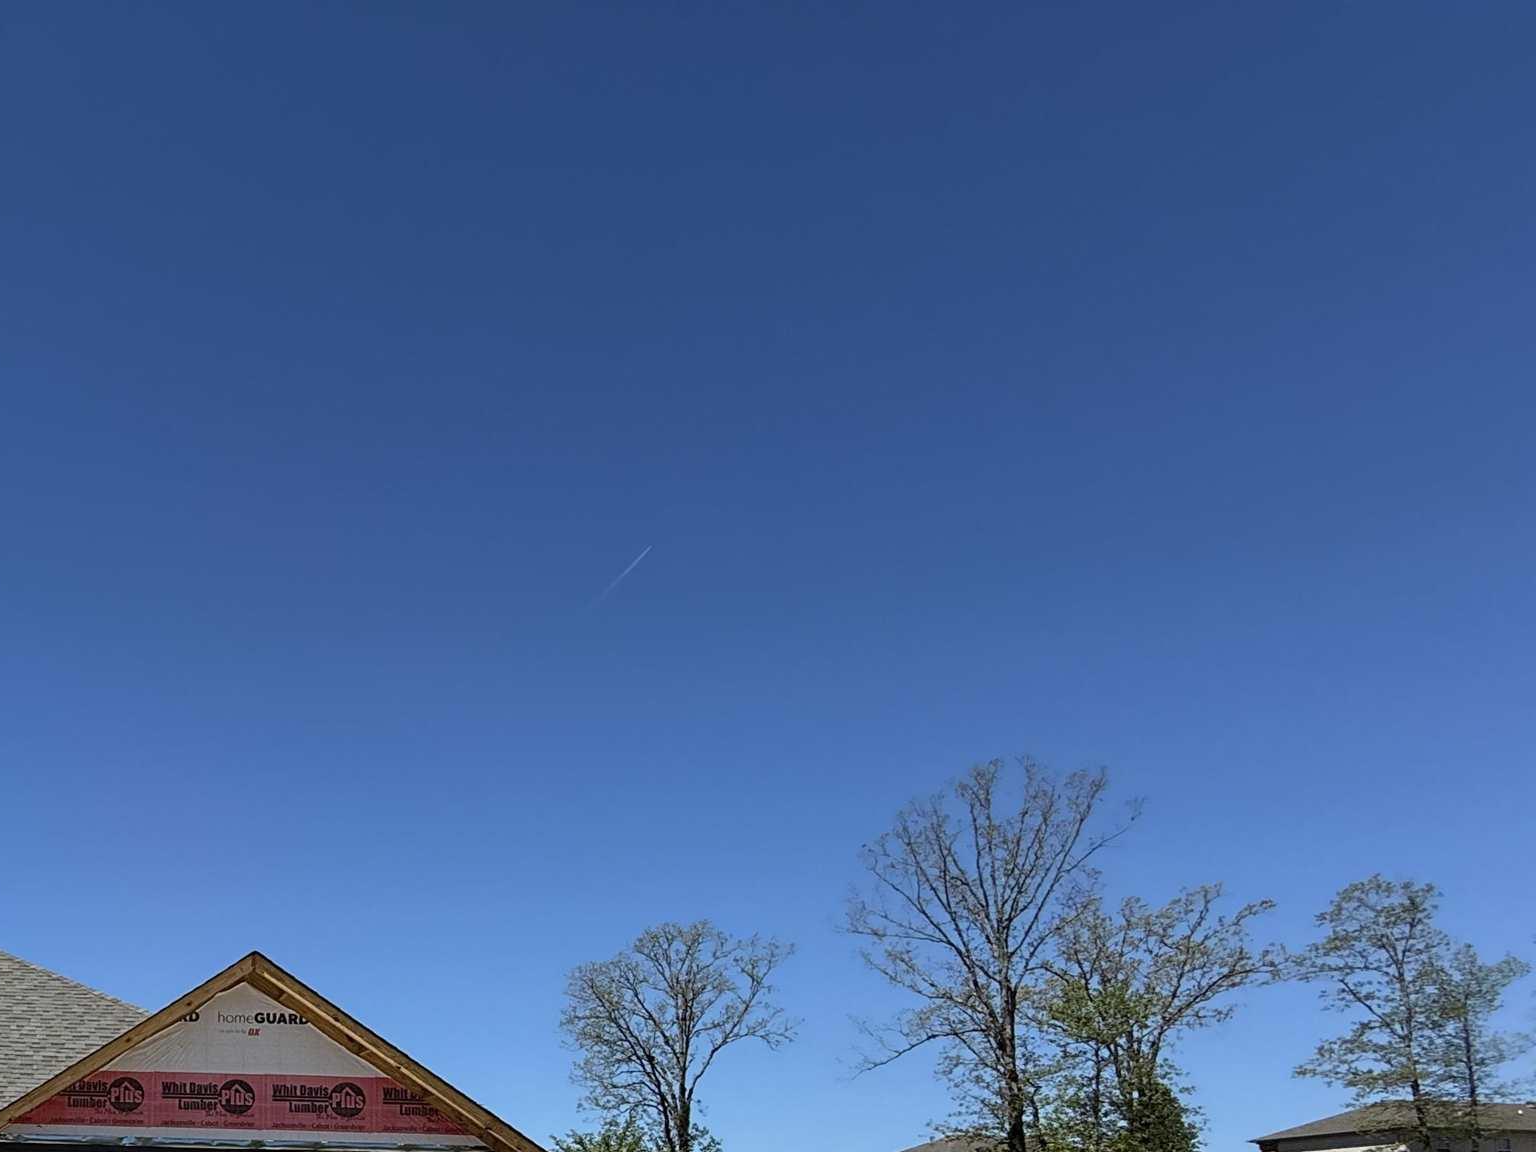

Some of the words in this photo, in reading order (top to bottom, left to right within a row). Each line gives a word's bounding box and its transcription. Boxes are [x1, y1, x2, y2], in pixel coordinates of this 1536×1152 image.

[161, 1082, 188, 1093] Whit
[190, 1083, 218, 1094] Davis
[272, 1084, 298, 1096] Whit
[300, 1085, 329, 1096] Davis
[383, 1087, 408, 1099] Whit
[111, 1086, 142, 1103] Plus
[221, 1089, 253, 1106] Plus
[332, 1092, 363, 1109] Plus
[178, 1099, 218, 1110] Lumber
[288, 1102, 329, 1113] Lumber
